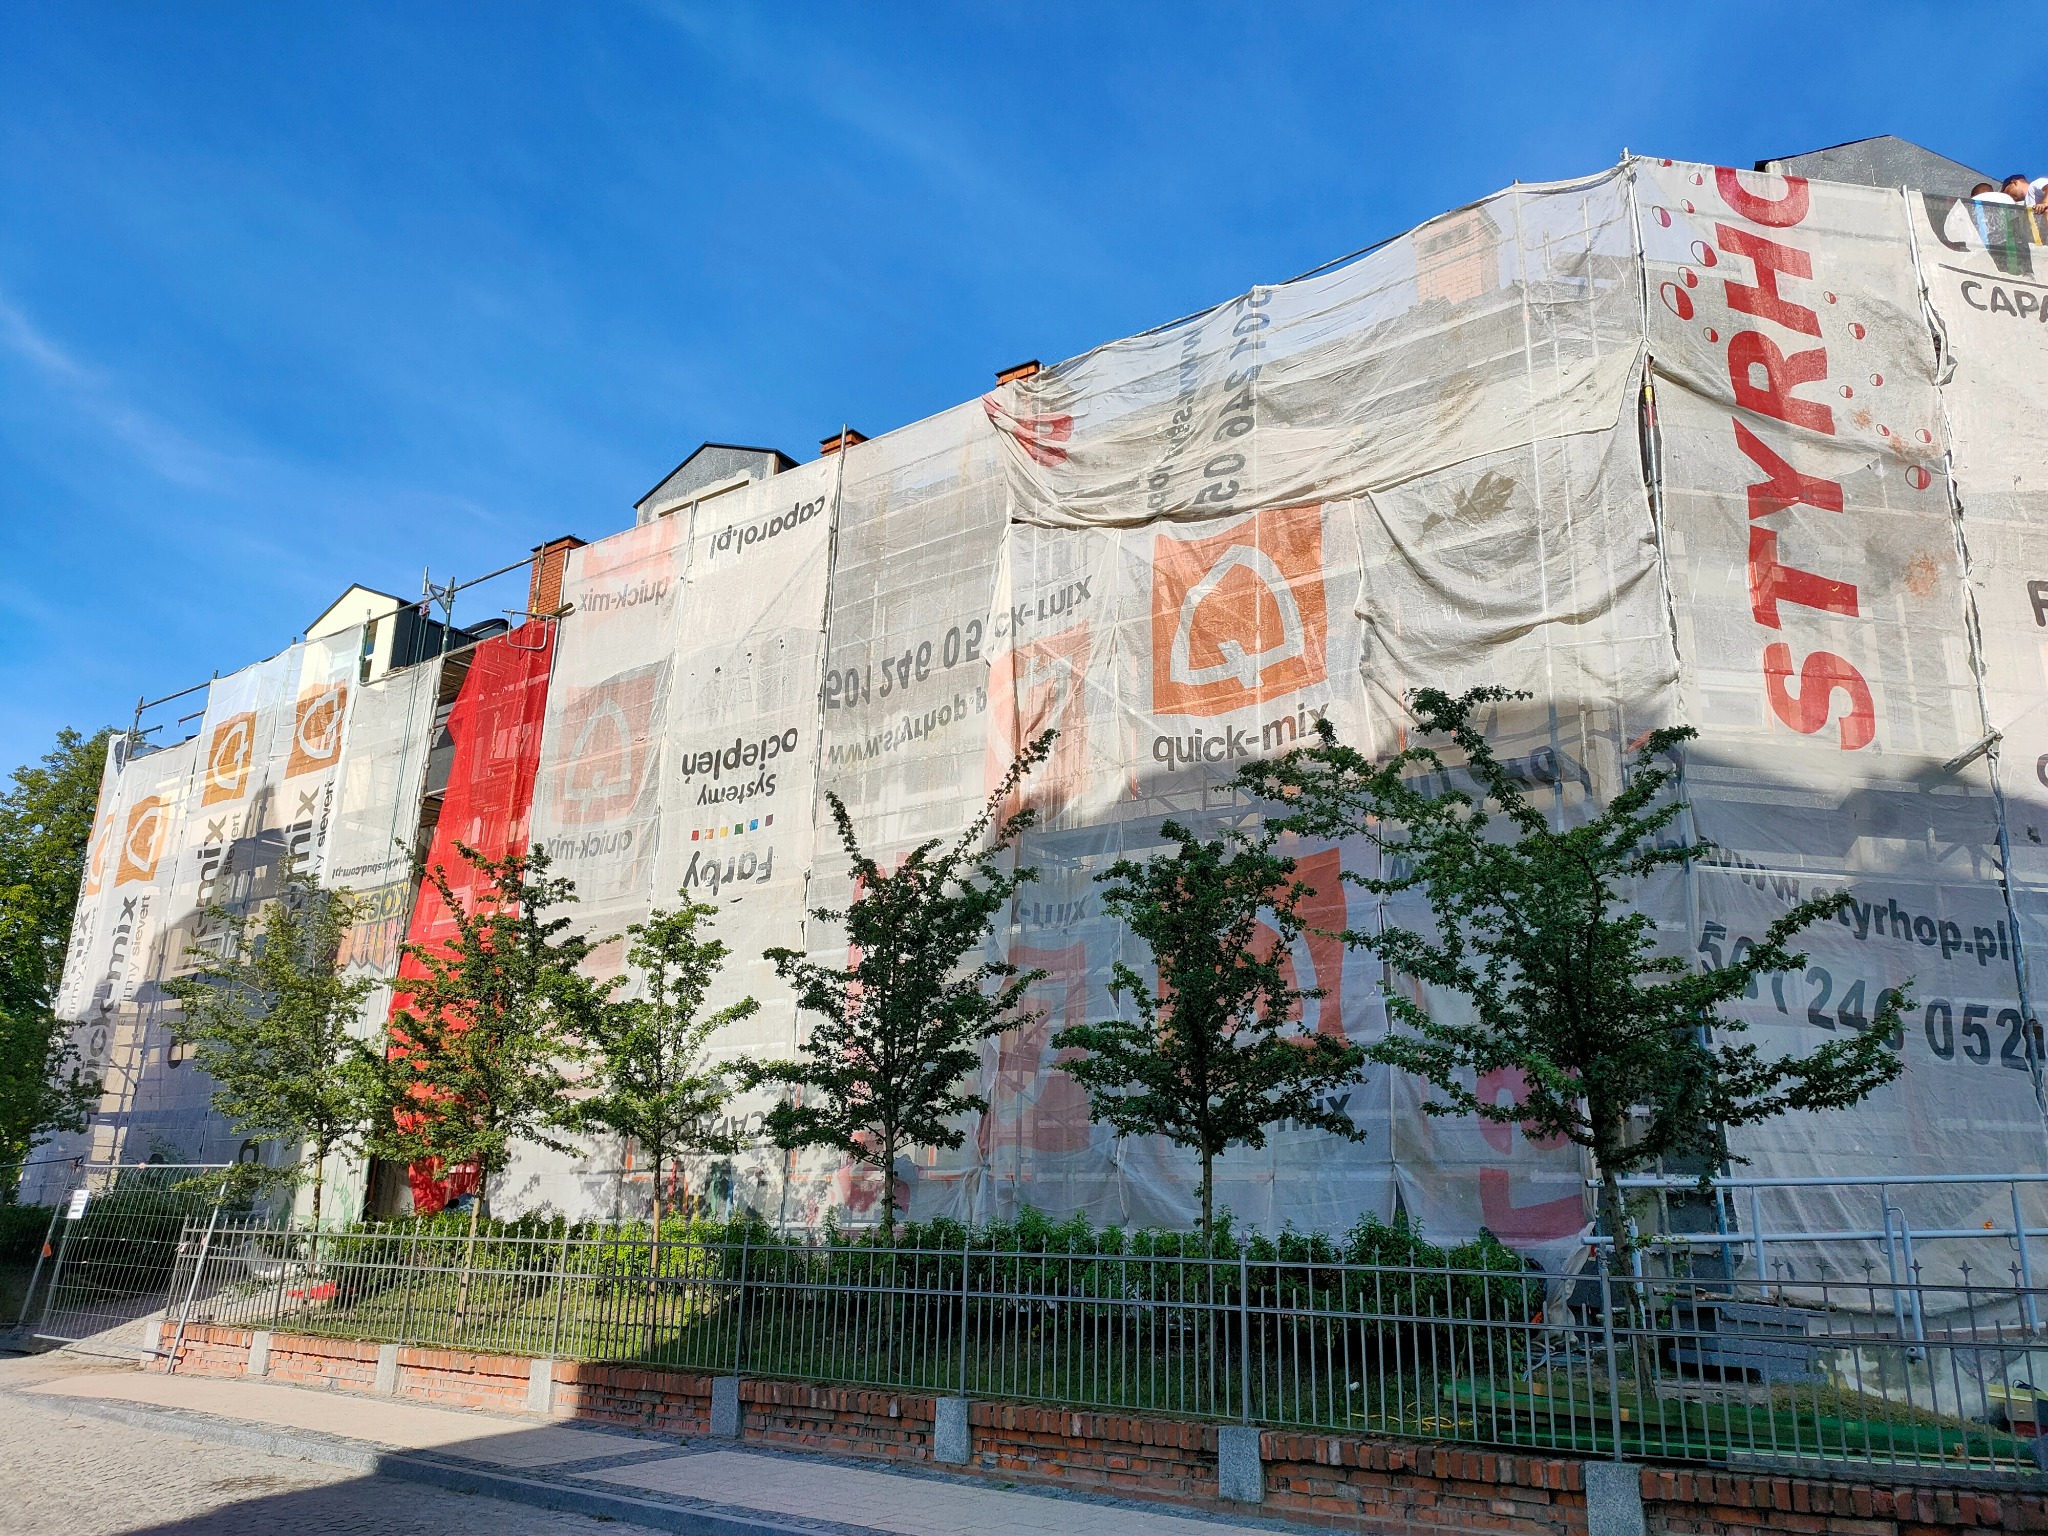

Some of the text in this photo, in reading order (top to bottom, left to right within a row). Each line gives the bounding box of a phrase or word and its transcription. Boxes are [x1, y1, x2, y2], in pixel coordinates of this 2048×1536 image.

[709, 495, 825, 559] caparol.pl
[1152, 702, 1330, 772] quick-mix
[697, 771, 777, 806] Systemy
[682, 845, 774, 897] Farby
